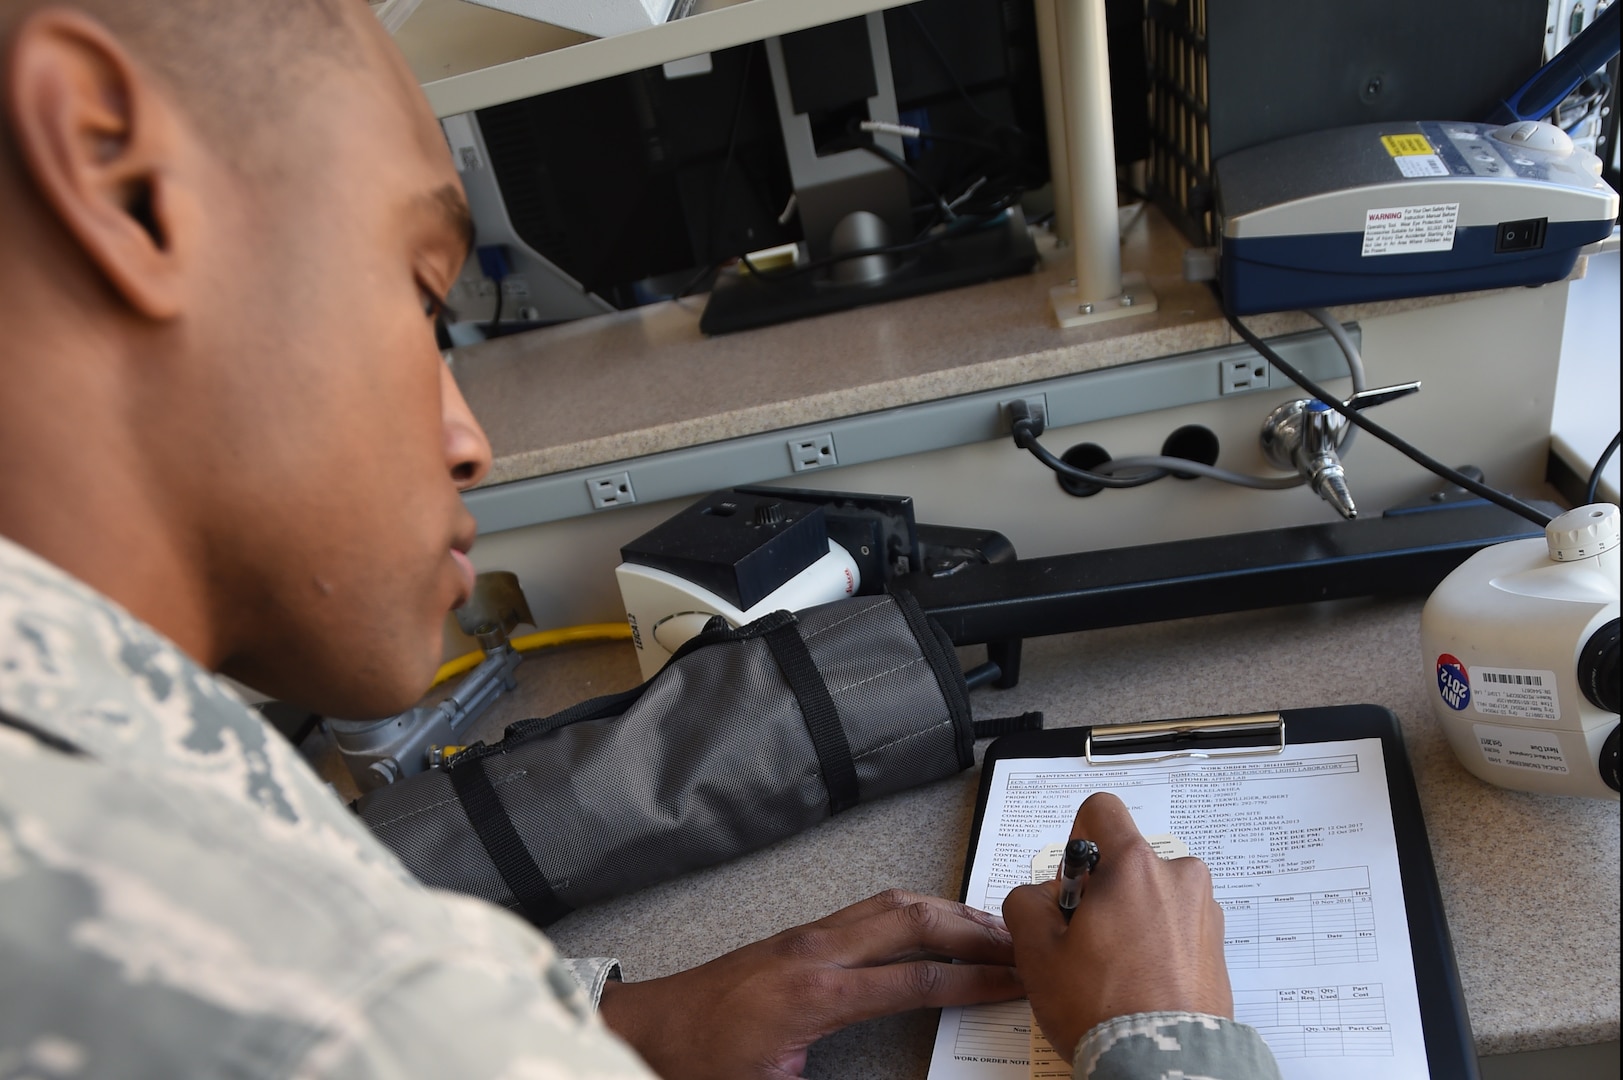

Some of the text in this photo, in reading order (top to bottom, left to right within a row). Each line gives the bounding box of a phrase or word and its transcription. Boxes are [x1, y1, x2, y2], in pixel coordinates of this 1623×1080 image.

[1369, 212, 1402, 220] WARNING
[631, 624, 643, 650] LEICA
[1440, 668, 1468, 699] 2012
[1441, 686, 1460, 708] INV
[1298, 764, 1343, 772] LABORATORY
[1506, 759, 1541, 769] ENGINEERING
[1542, 764, 1566, 772] CLINICAL
